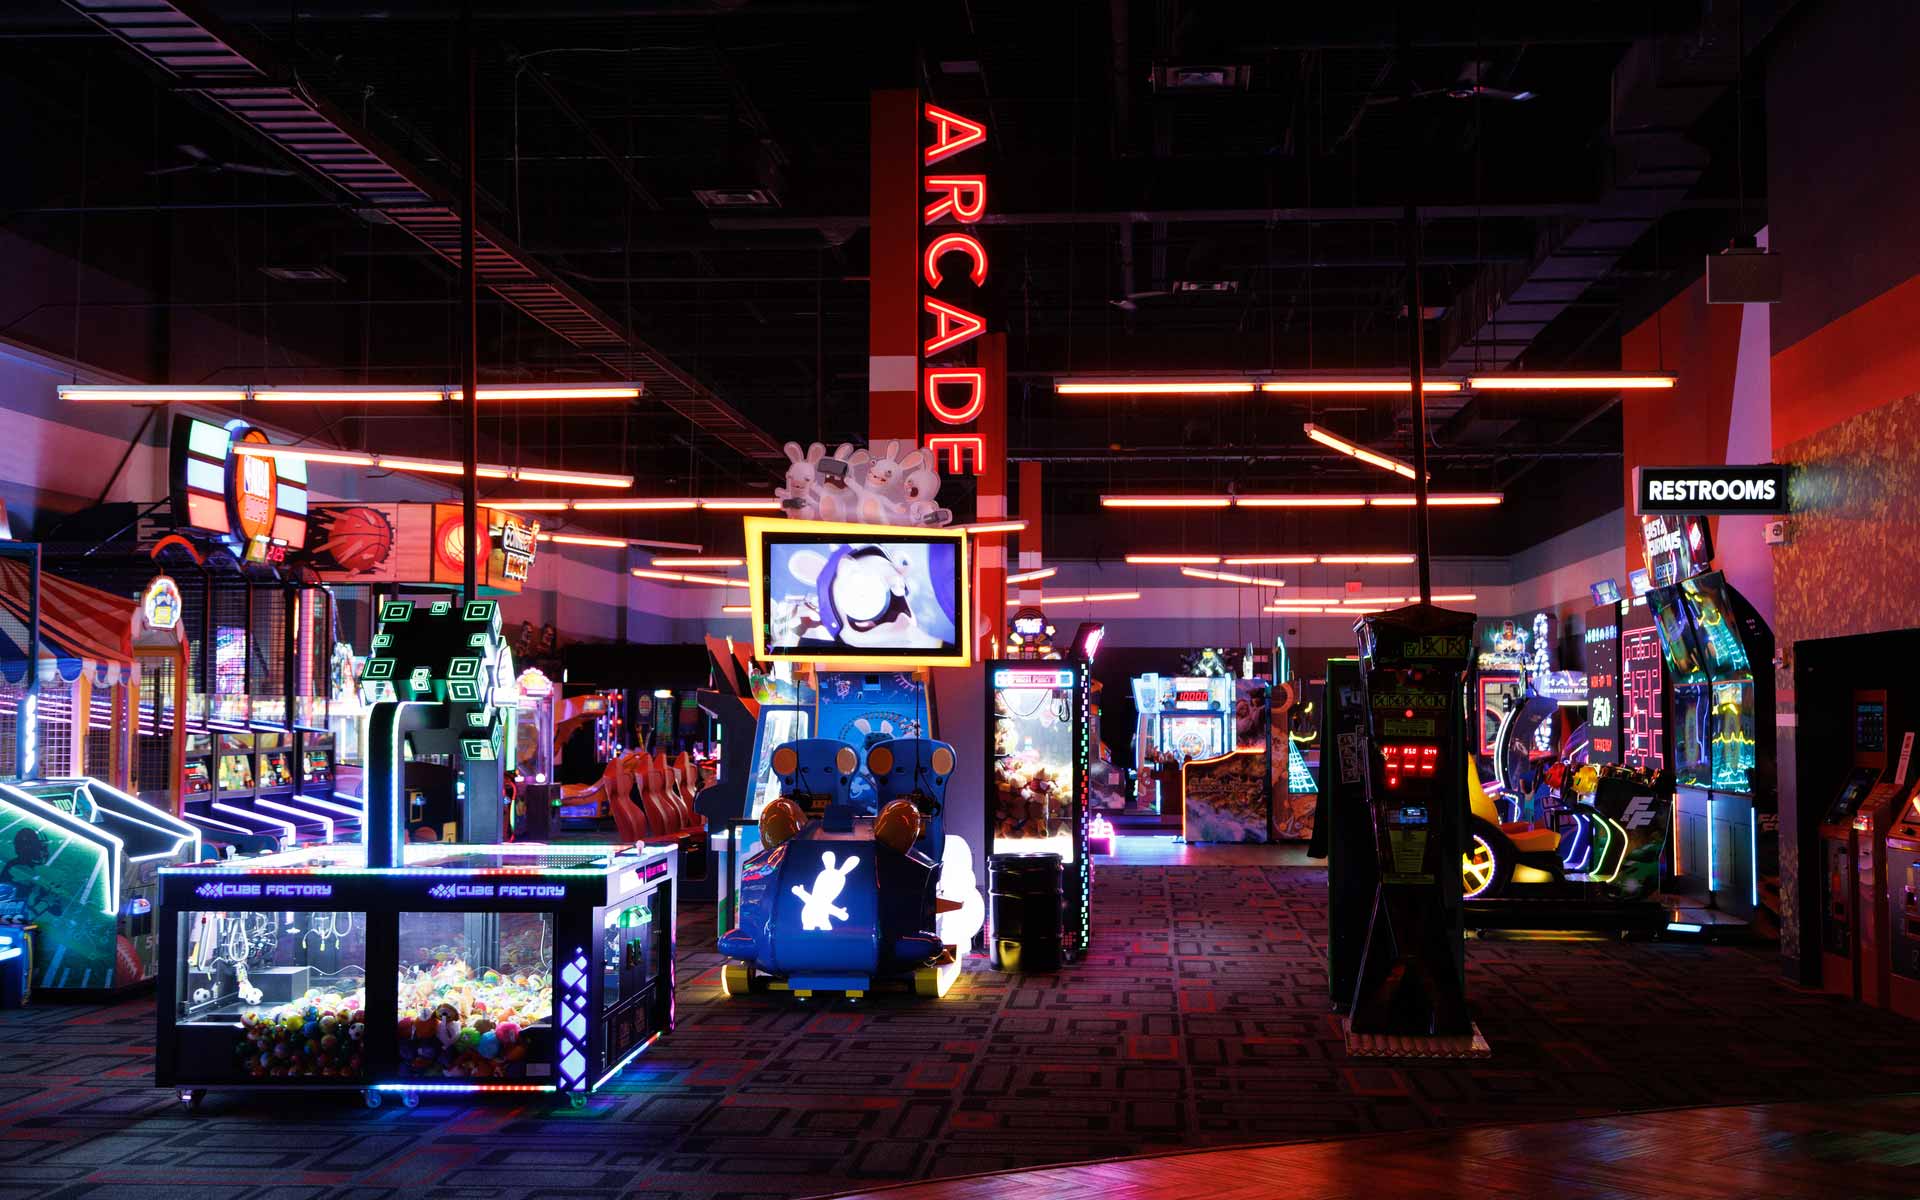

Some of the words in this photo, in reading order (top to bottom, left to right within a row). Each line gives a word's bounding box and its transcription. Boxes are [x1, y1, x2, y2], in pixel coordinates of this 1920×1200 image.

[924, 102, 987, 476] ARCADE
[1649, 479, 1776, 501] RESTROOMS
[223, 884, 262, 896] CUBE
[265, 884, 332, 896] FACTORY
[456, 885, 494, 896] CUBE
[498, 885, 565, 896] FACTORY
